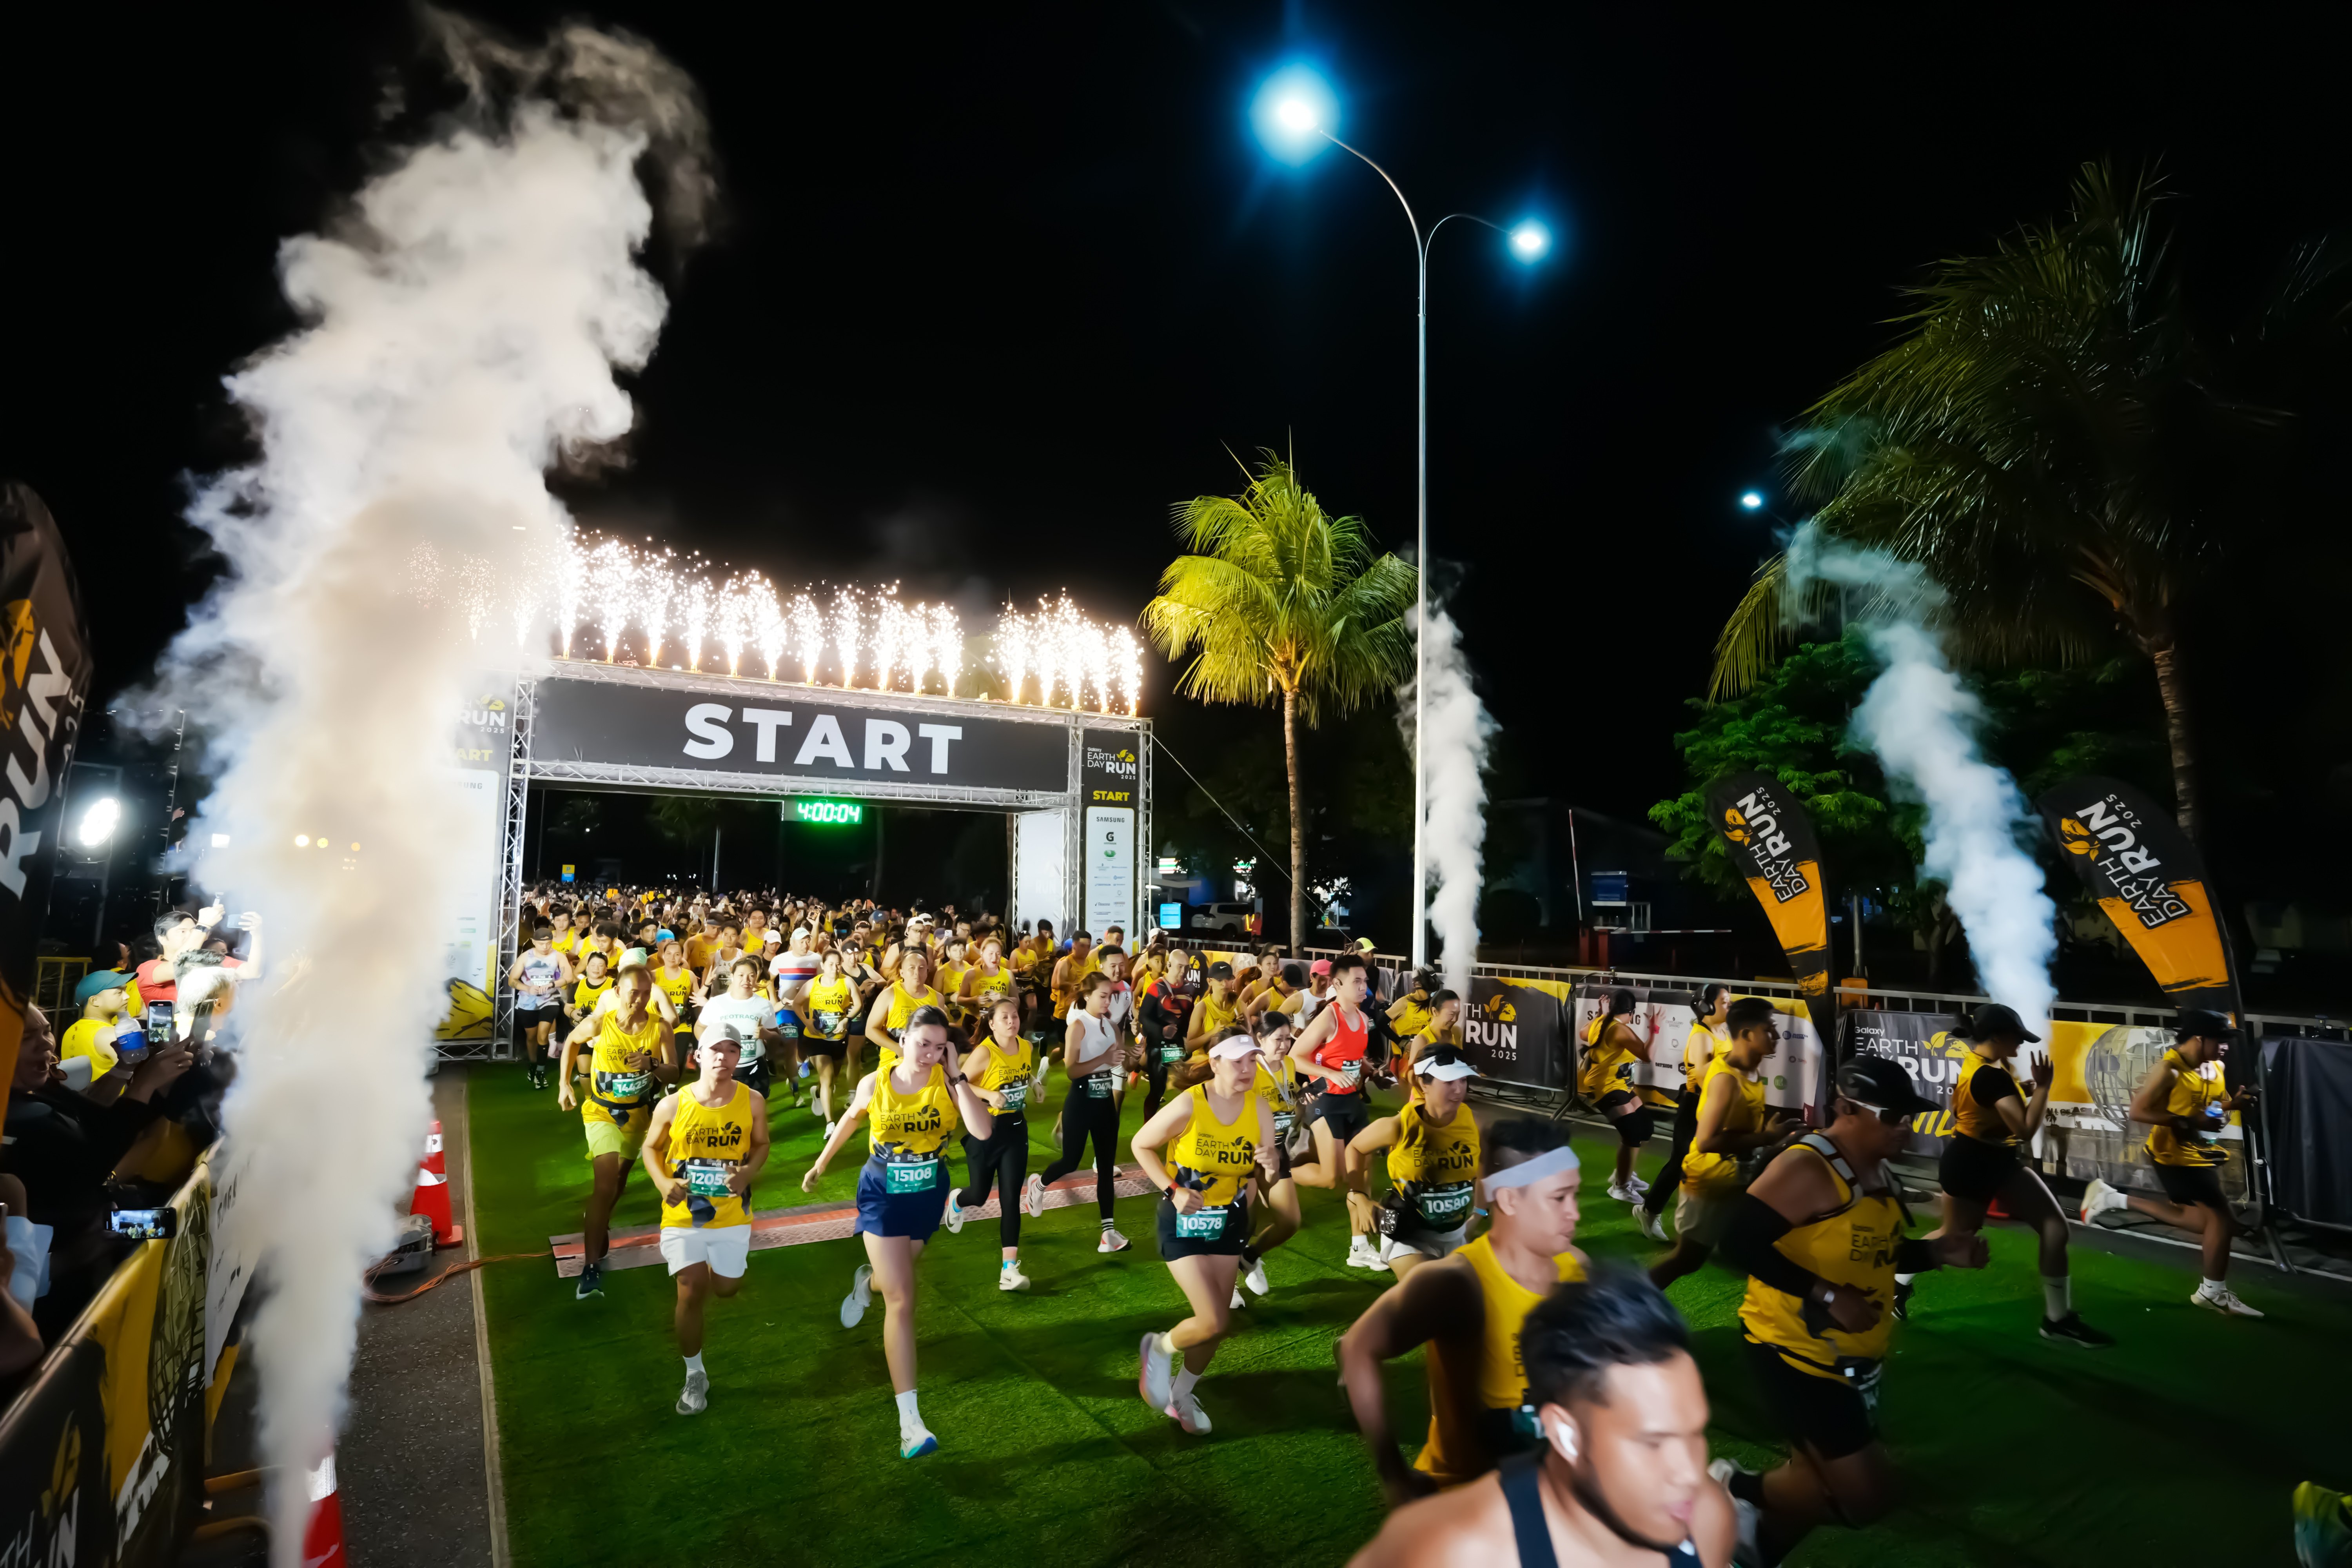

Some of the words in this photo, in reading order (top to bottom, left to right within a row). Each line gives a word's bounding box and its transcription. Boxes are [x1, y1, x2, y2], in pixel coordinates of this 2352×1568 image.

[456, 709, 506, 727] RUN
[683, 703, 962, 774] START
[457, 748, 493, 761] ART
[1087, 752, 1115, 761] EARTH
[1106, 761, 1136, 775] RUN
[1093, 790, 1130, 801] START
[1756, 786, 1781, 815] 2025
[798, 802, 860, 822] 4:00:04
[2106, 794, 2142, 828] 2025
[1736, 792, 1792, 858] RUN
[1106, 832, 1114, 842] G
[2076, 800, 2161, 874] RUN
[1749, 843, 1793, 901] EARTH
[1775, 858, 1807, 893] DAY
[2098, 857, 2167, 926] EARTH
[2137, 877, 2188, 917] DAY
[1187, 969, 1200, 982] UN
[1466, 1020, 1517, 1049] RUN
[1855, 1026, 1885, 1036] Galaxy
[1856, 1037, 1918, 1055] EARTH
[1491, 1049, 1516, 1060] 2025
[617, 1078, 647, 1093] 14425
[1936, 1085, 1954, 1095] 20
[881, 1113, 915, 1122] EARTH
[904, 1117, 940, 1133] RUN
[1275, 1119, 1291, 1129] 579
[686, 1128, 719, 1137] EARTH
[708, 1135, 740, 1147] RUN
[1197, 1139, 1229, 1150] EARTH
[1195, 1147, 1217, 1157] DAY
[1218, 1151, 1252, 1165] RUN
[1414, 1149, 1448, 1158] EARTH
[1438, 1154, 1474, 1170] RUN
[691, 1172, 727, 1186] 1205
[893, 1167, 932, 1182] 15108
[1426, 1195, 1470, 1214] 10580
[1181, 1217, 1222, 1230] 10578
